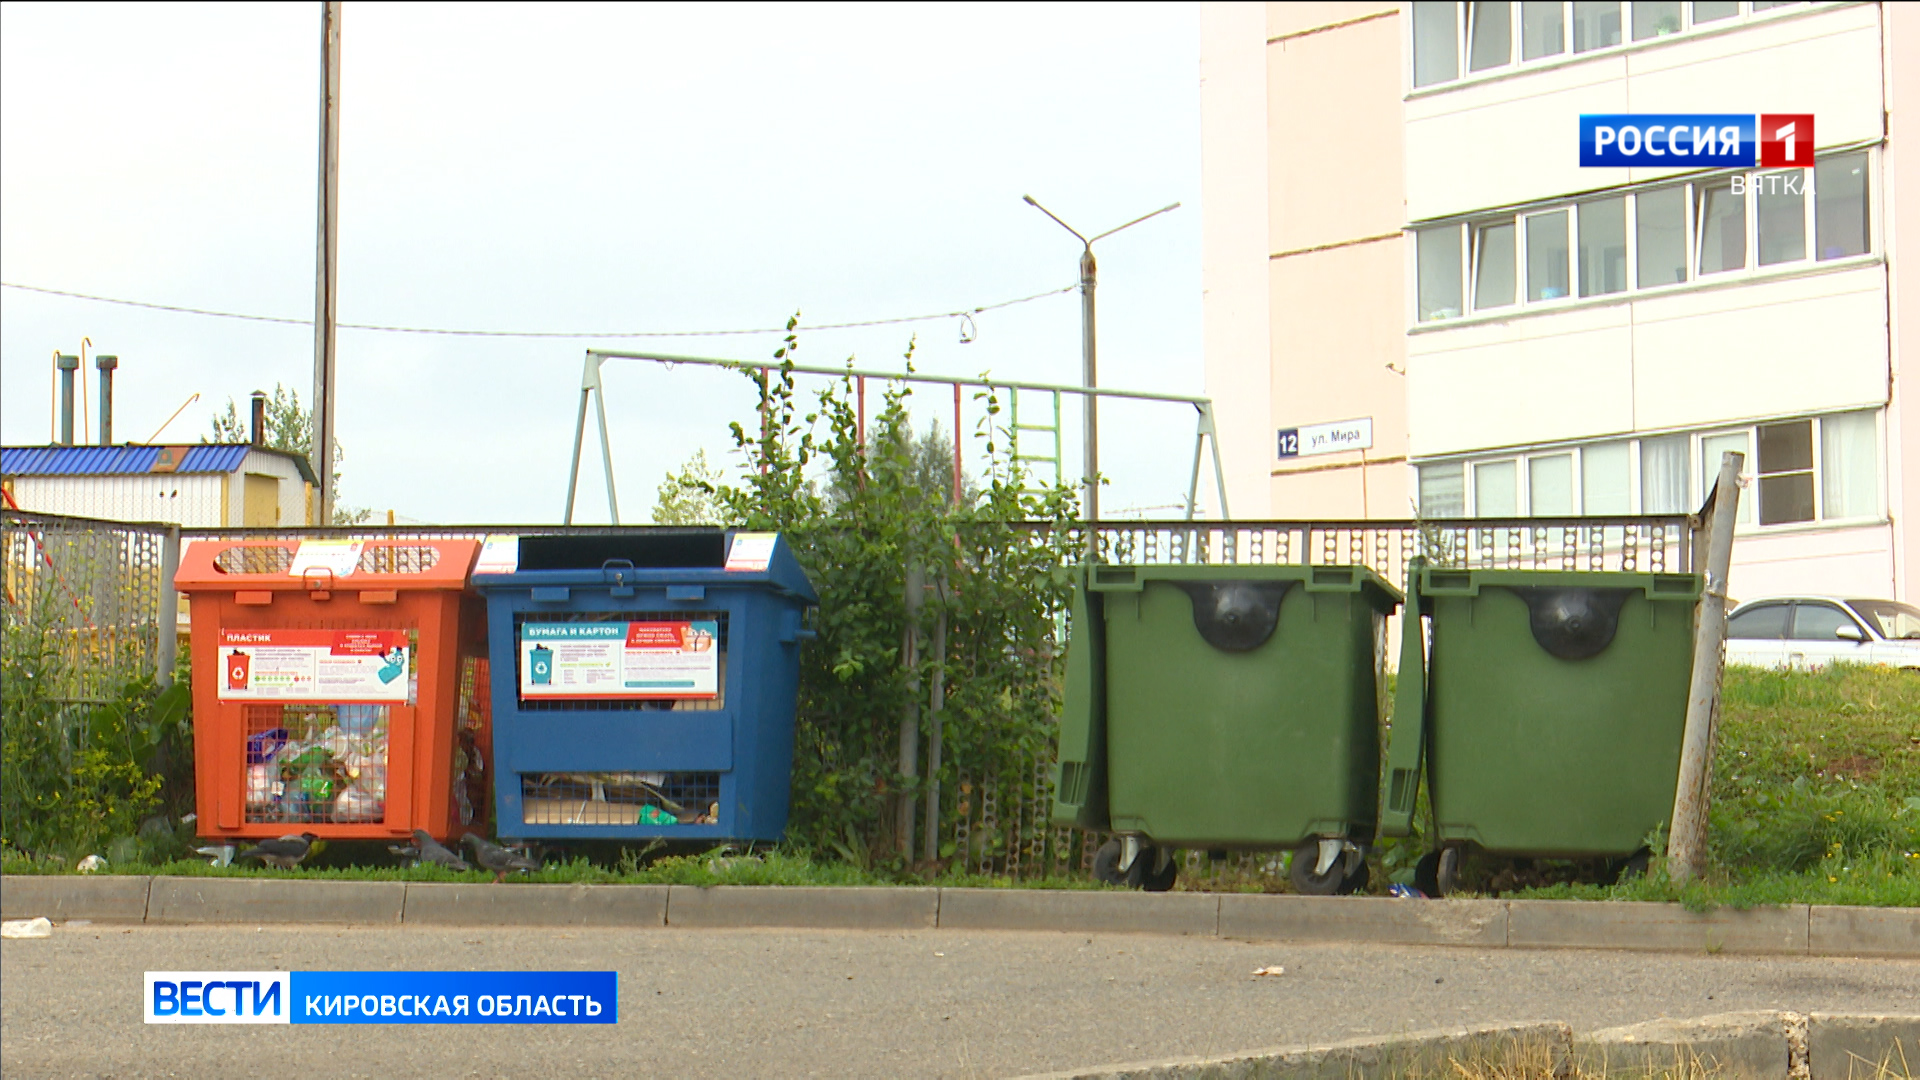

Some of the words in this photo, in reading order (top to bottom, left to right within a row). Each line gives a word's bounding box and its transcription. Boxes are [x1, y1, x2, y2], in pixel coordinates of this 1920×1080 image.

[1279, 434, 1297, 454] 12
[1311, 434, 1328, 447] ул.
[1331, 429, 1360, 443] Мира
[528, 627, 568, 636] БУМАГА
[569, 627, 577, 636] И
[579, 627, 619, 636] КАРТОН
[226, 633, 271, 642] ПЛАСТИК
